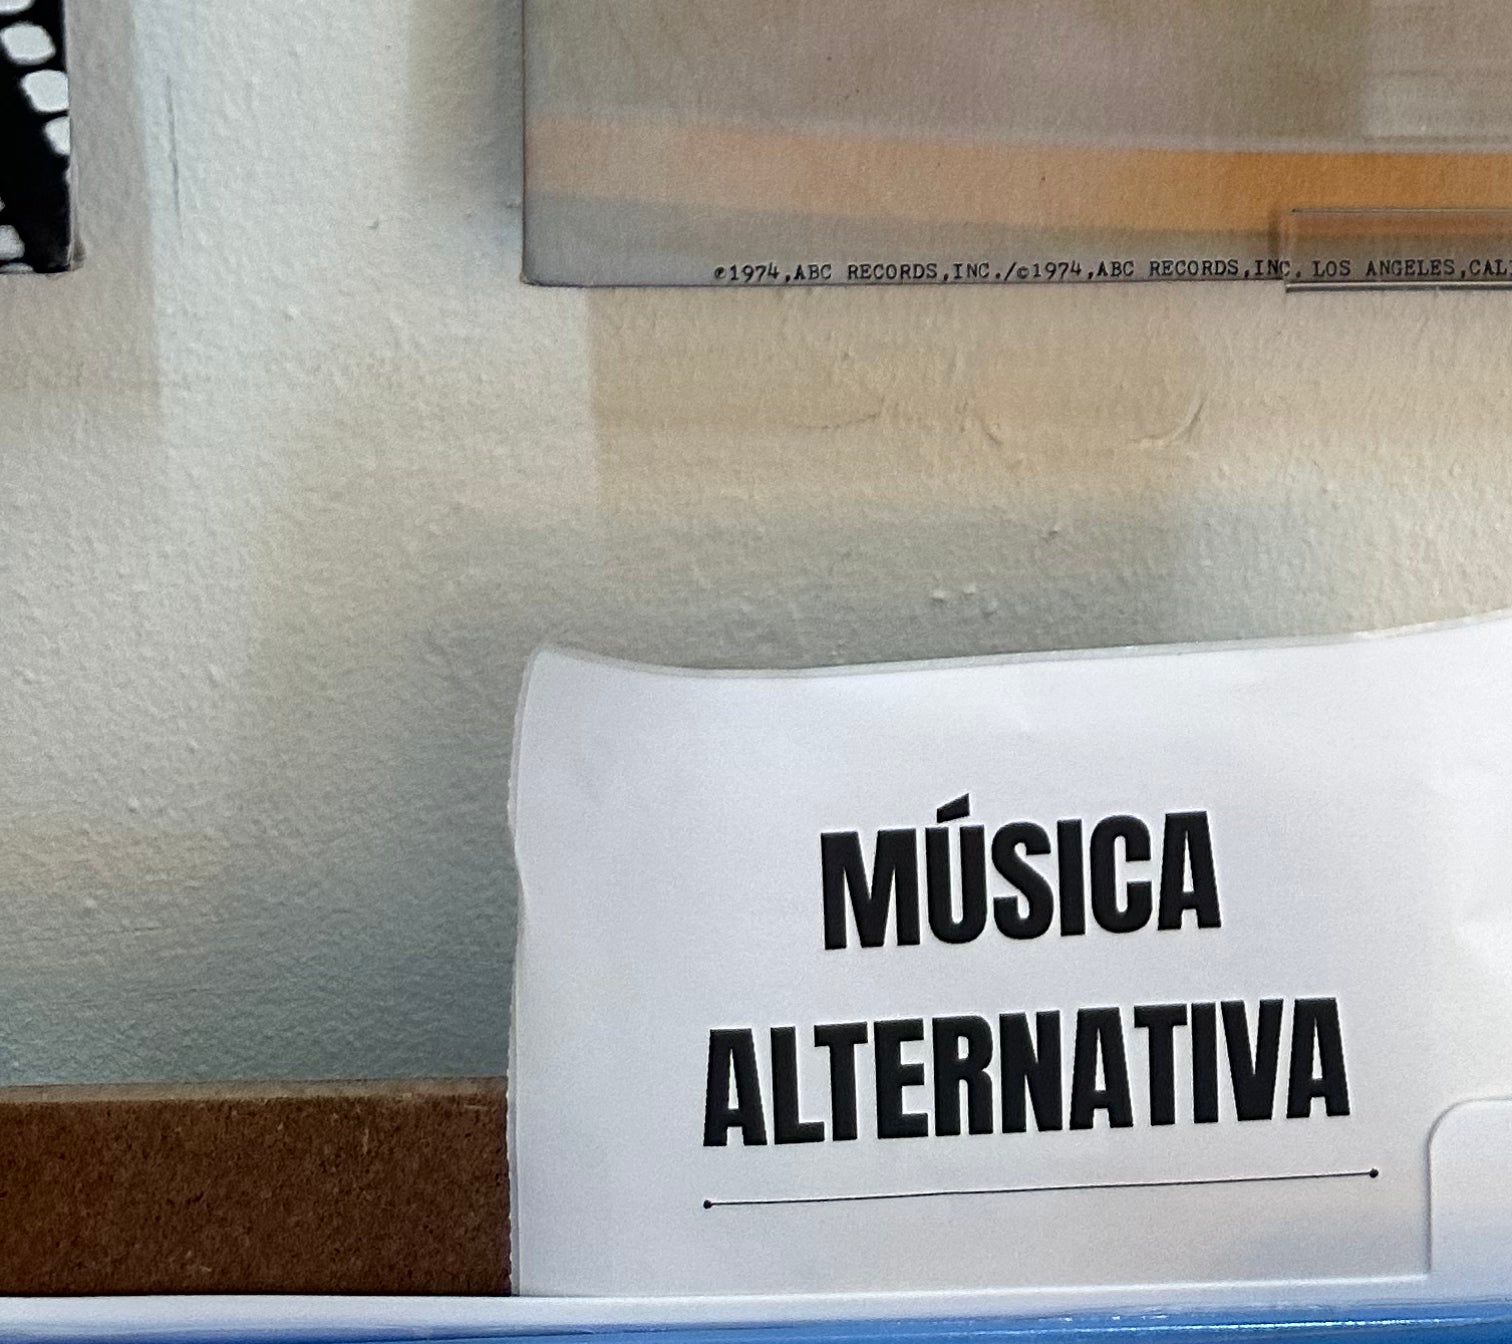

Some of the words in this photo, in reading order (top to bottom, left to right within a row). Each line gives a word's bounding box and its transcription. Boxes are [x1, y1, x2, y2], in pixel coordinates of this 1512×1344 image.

[1312, 260, 1350, 277] LOS
[820, 792, 1221, 950] MÚSICA
[703, 996, 1351, 1147] ALTERNATIVA
